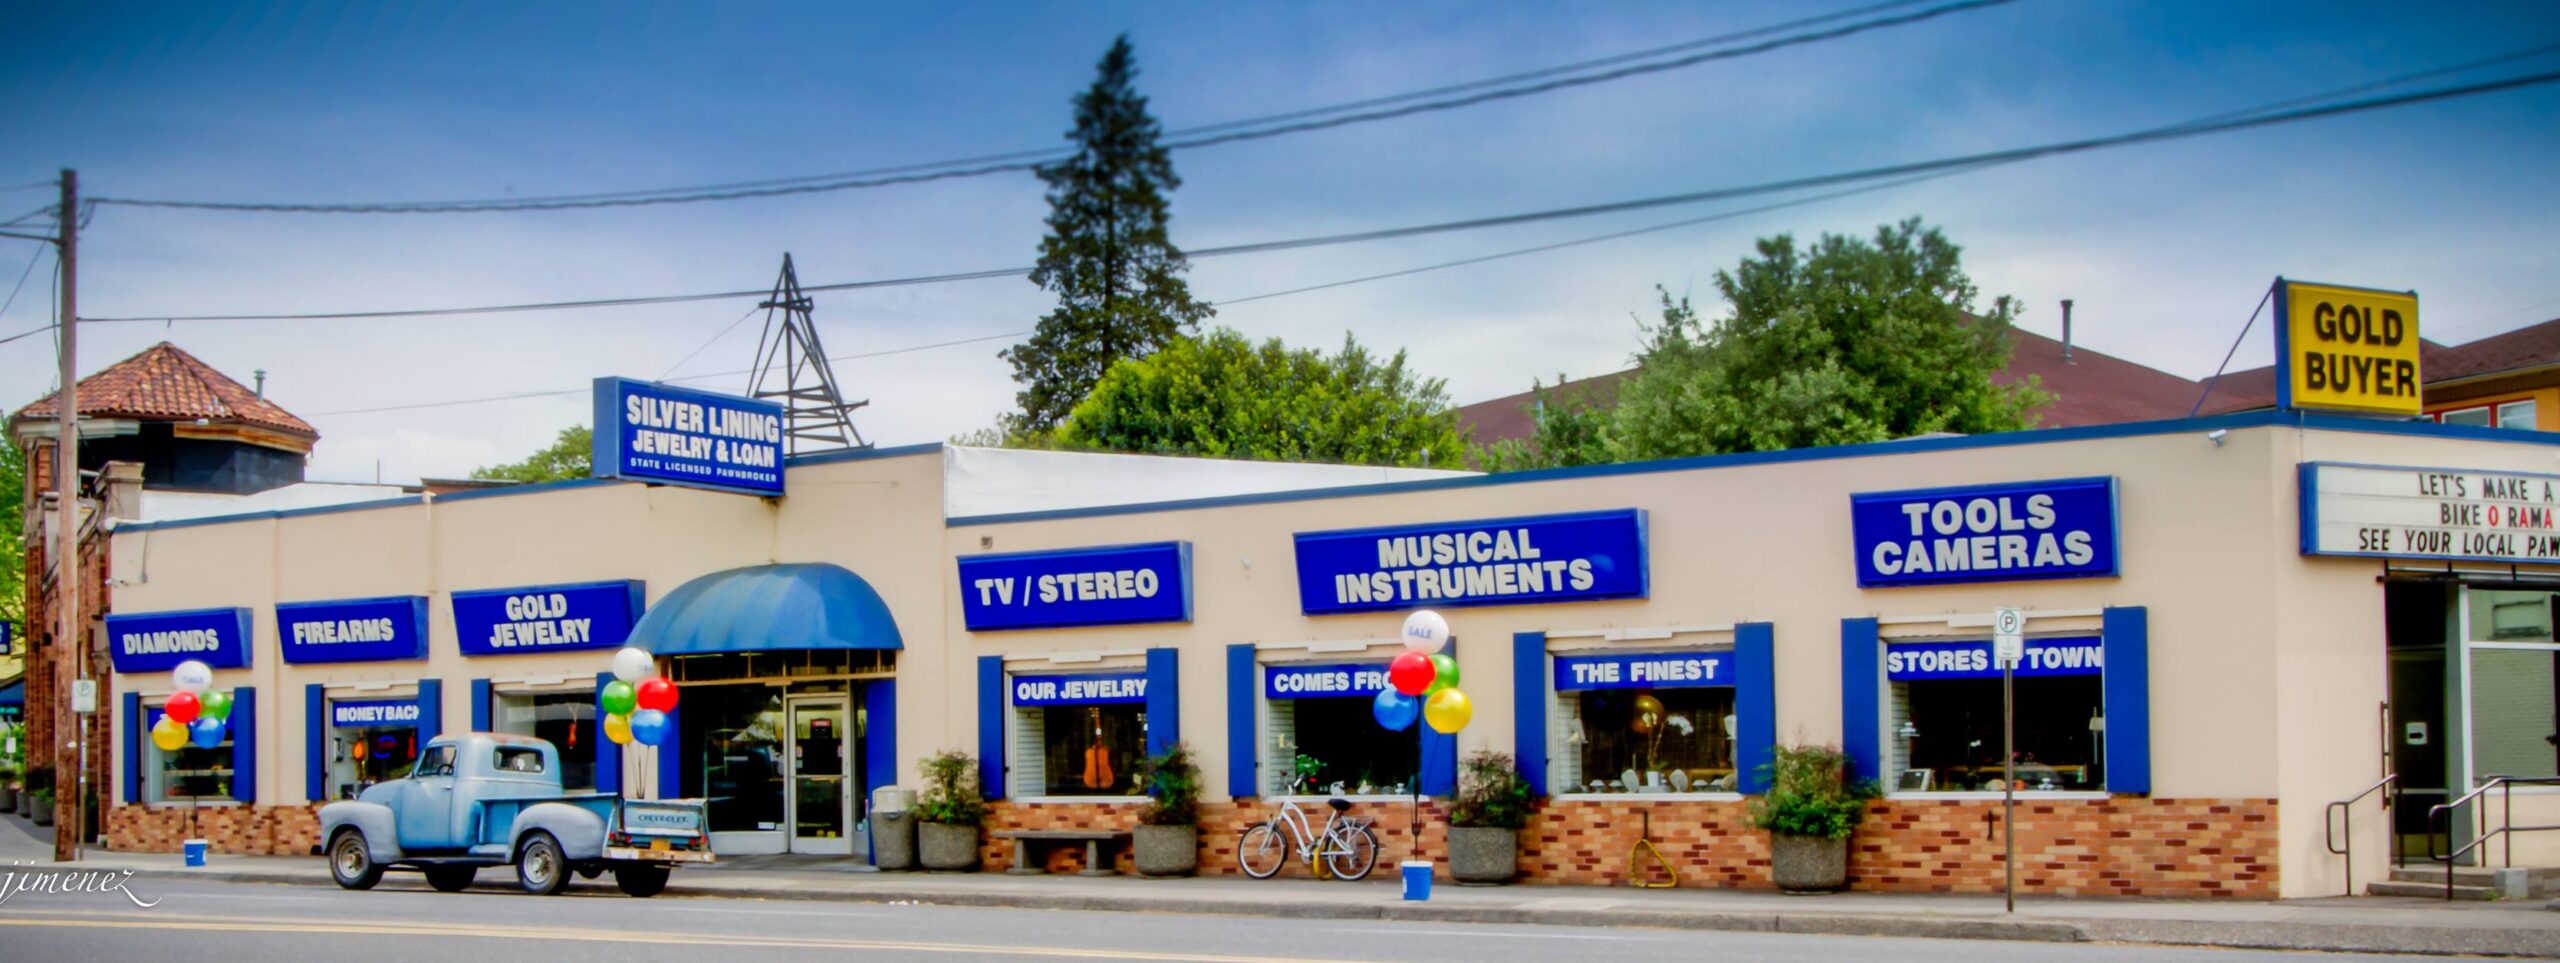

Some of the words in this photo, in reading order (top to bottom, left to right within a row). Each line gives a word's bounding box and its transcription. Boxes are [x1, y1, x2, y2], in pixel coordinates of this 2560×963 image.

[2314, 301, 2404, 347] GOLD
[2305, 351, 2416, 398] BUYER
[626, 394, 705, 433] SILVER
[708, 406, 780, 443] LINING
[632, 429, 712, 460] JEWELRY
[716, 439, 729, 463] &
[731, 442, 775, 468] LOAN
[630, 457, 661, 470] STATE
[665, 462, 712, 475] LICENSED
[716, 467, 777, 482] PAWNBROKER
[2418, 473, 2466, 498] LET'S
[2483, 478, 2528, 501] MAKE
[2544, 481, 2554, 502] A
[1902, 494, 2056, 536] TOOLS
[2440, 502, 2481, 526] BIKE
[2487, 505, 2499, 527] O
[2508, 506, 2553, 529] RAMA
[1377, 529, 1541, 569] MUSICAL
[1873, 530, 2093, 575] CAMERAS
[2359, 527, 2391, 550] SEE
[2404, 529, 2451, 553] YOUR
[2463, 533, 2515, 556] LOCAL
[975, 577, 1014, 606] TV
[1023, 575, 1032, 607] /
[1038, 568, 1159, 603] STEREO
[1335, 558, 1594, 604] INSTRUMENTS
[505, 593, 568, 621] GOLD
[122, 628, 219, 655] DIAMONDS
[292, 617, 395, 645] FIREARMS
[489, 618, 591, 648] JEWELRY
[1408, 627, 1432, 639] SALE
[1572, 662, 1620, 683] THE
[1630, 659, 1719, 682] FINEST
[1887, 649, 1988, 673] STORES
[2026, 646, 2102, 669] TOWN
[1017, 681, 1056, 700] OUR
[1060, 679, 1147, 699] JEWELRY
[1274, 671, 1350, 692] COMES
[1354, 670, 1398, 690] FRO
[336, 706, 384, 722] MONEY
